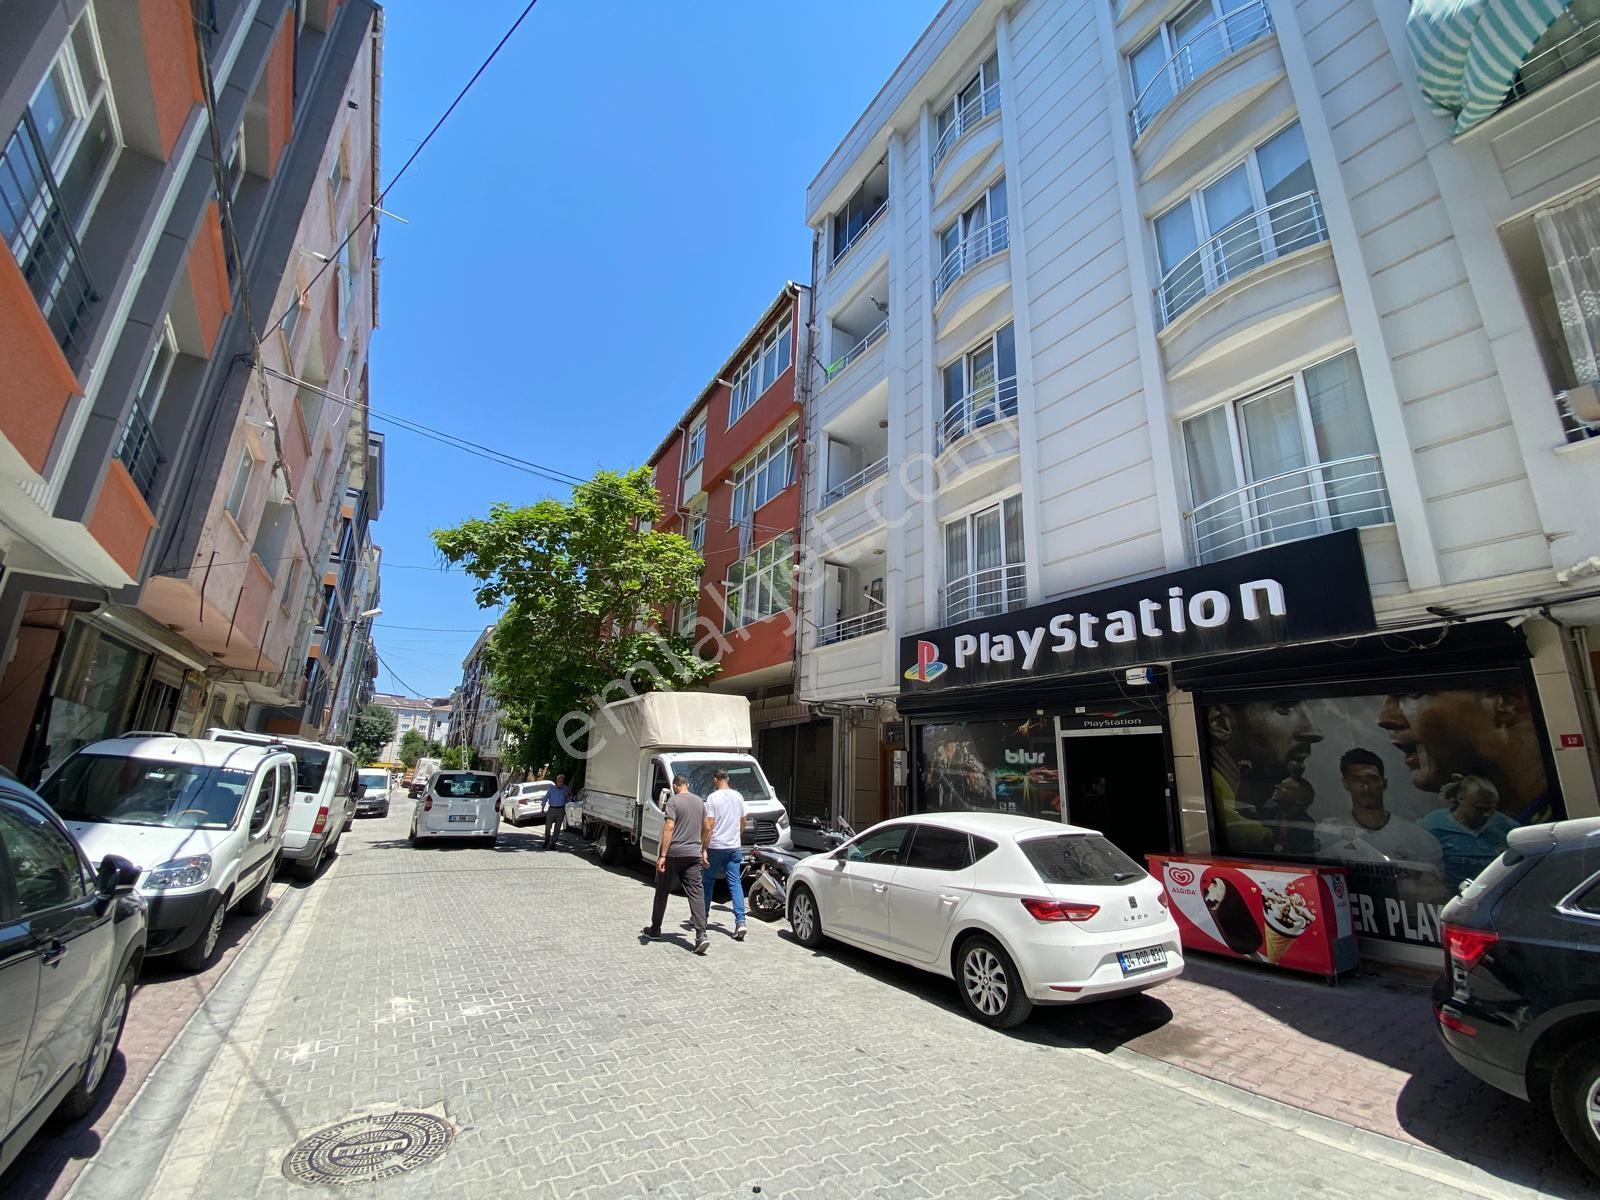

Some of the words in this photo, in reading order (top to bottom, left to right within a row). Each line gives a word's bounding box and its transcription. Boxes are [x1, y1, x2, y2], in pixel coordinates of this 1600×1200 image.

[954, 578, 1287, 670] PlayStation
[1083, 718, 1142, 728] PlayStation
[1567, 737, 1578, 745] 12
[1004, 748, 1046, 764] blur
[1171, 887, 1196, 896] ALGIDA
